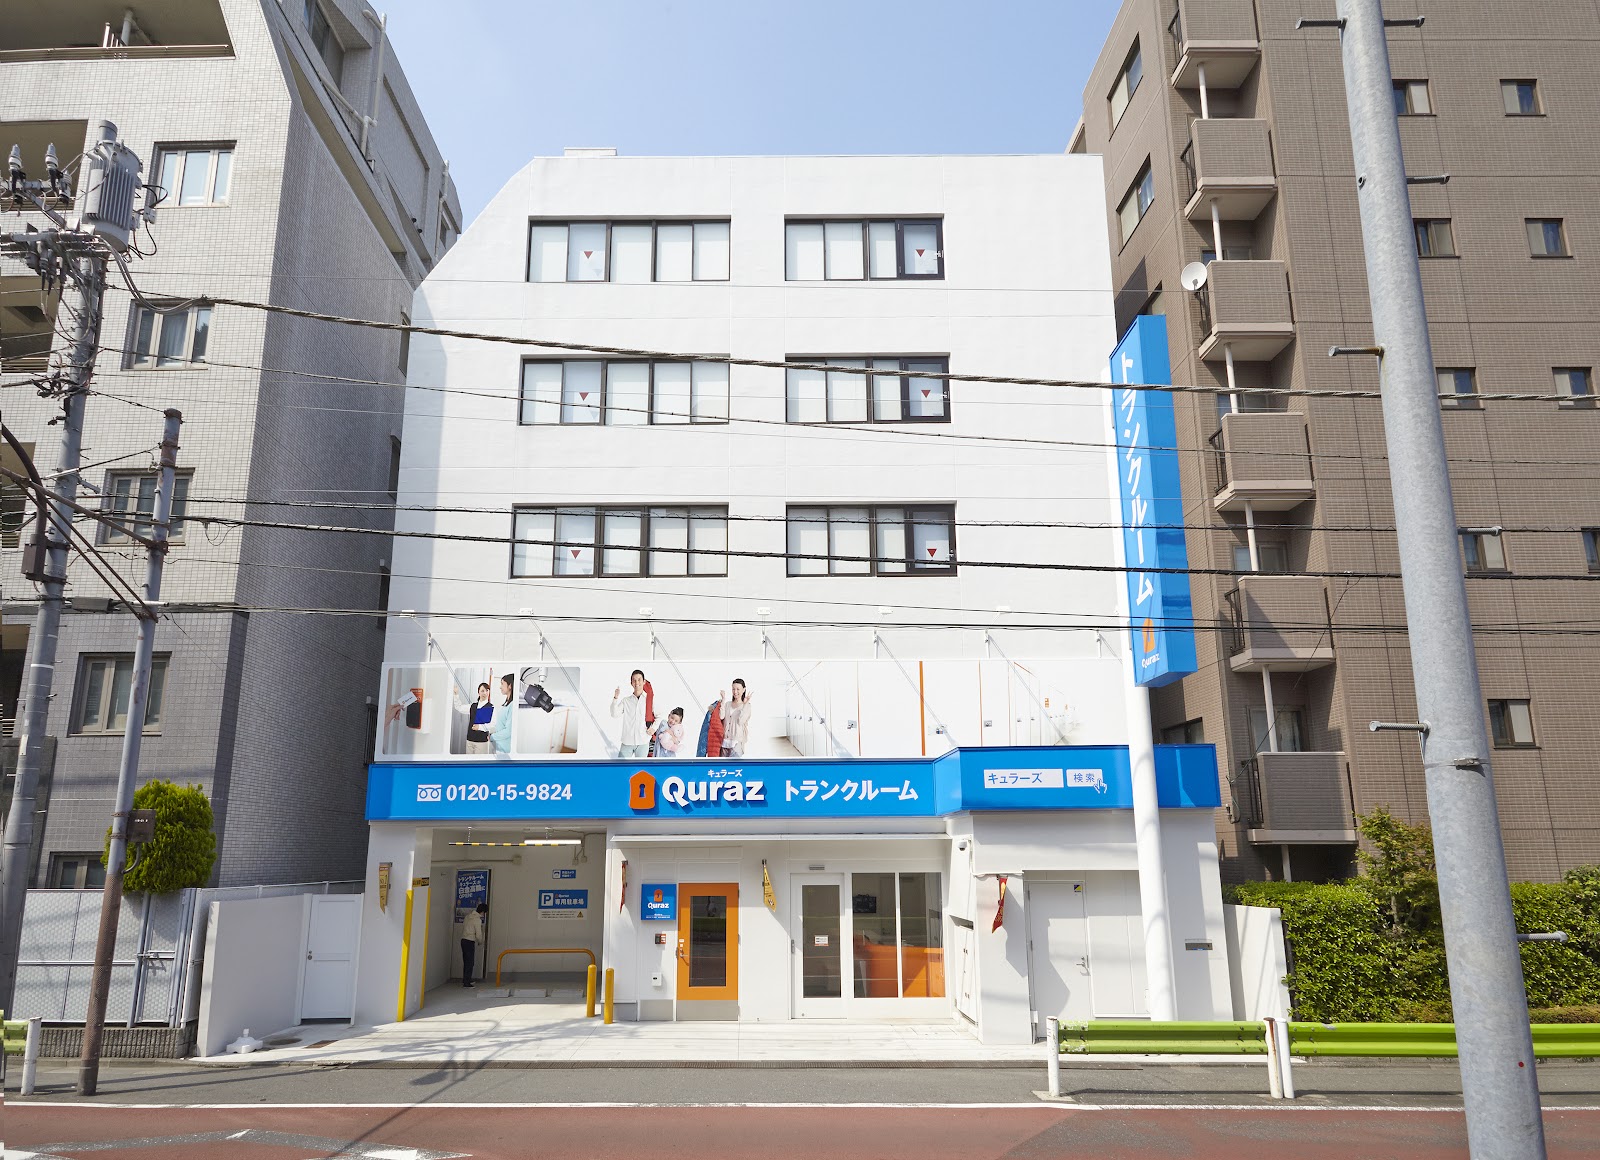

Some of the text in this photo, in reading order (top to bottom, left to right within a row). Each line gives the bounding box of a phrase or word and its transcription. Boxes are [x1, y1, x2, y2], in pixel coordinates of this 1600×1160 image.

[1121, 352, 1154, 606] トランクルーム
[1141, 652, 1160, 669] Quraz
[707, 769, 743, 778] キュラーズ
[987, 772, 1096, 785] キュラーズ 検索
[445, 784, 573, 801] 0120-15-9824
[662, 776, 765, 807] Quraz
[785, 779, 919, 801] トランクルーム
[543, 894, 552, 905] P
[647, 902, 670, 910] Quraz
